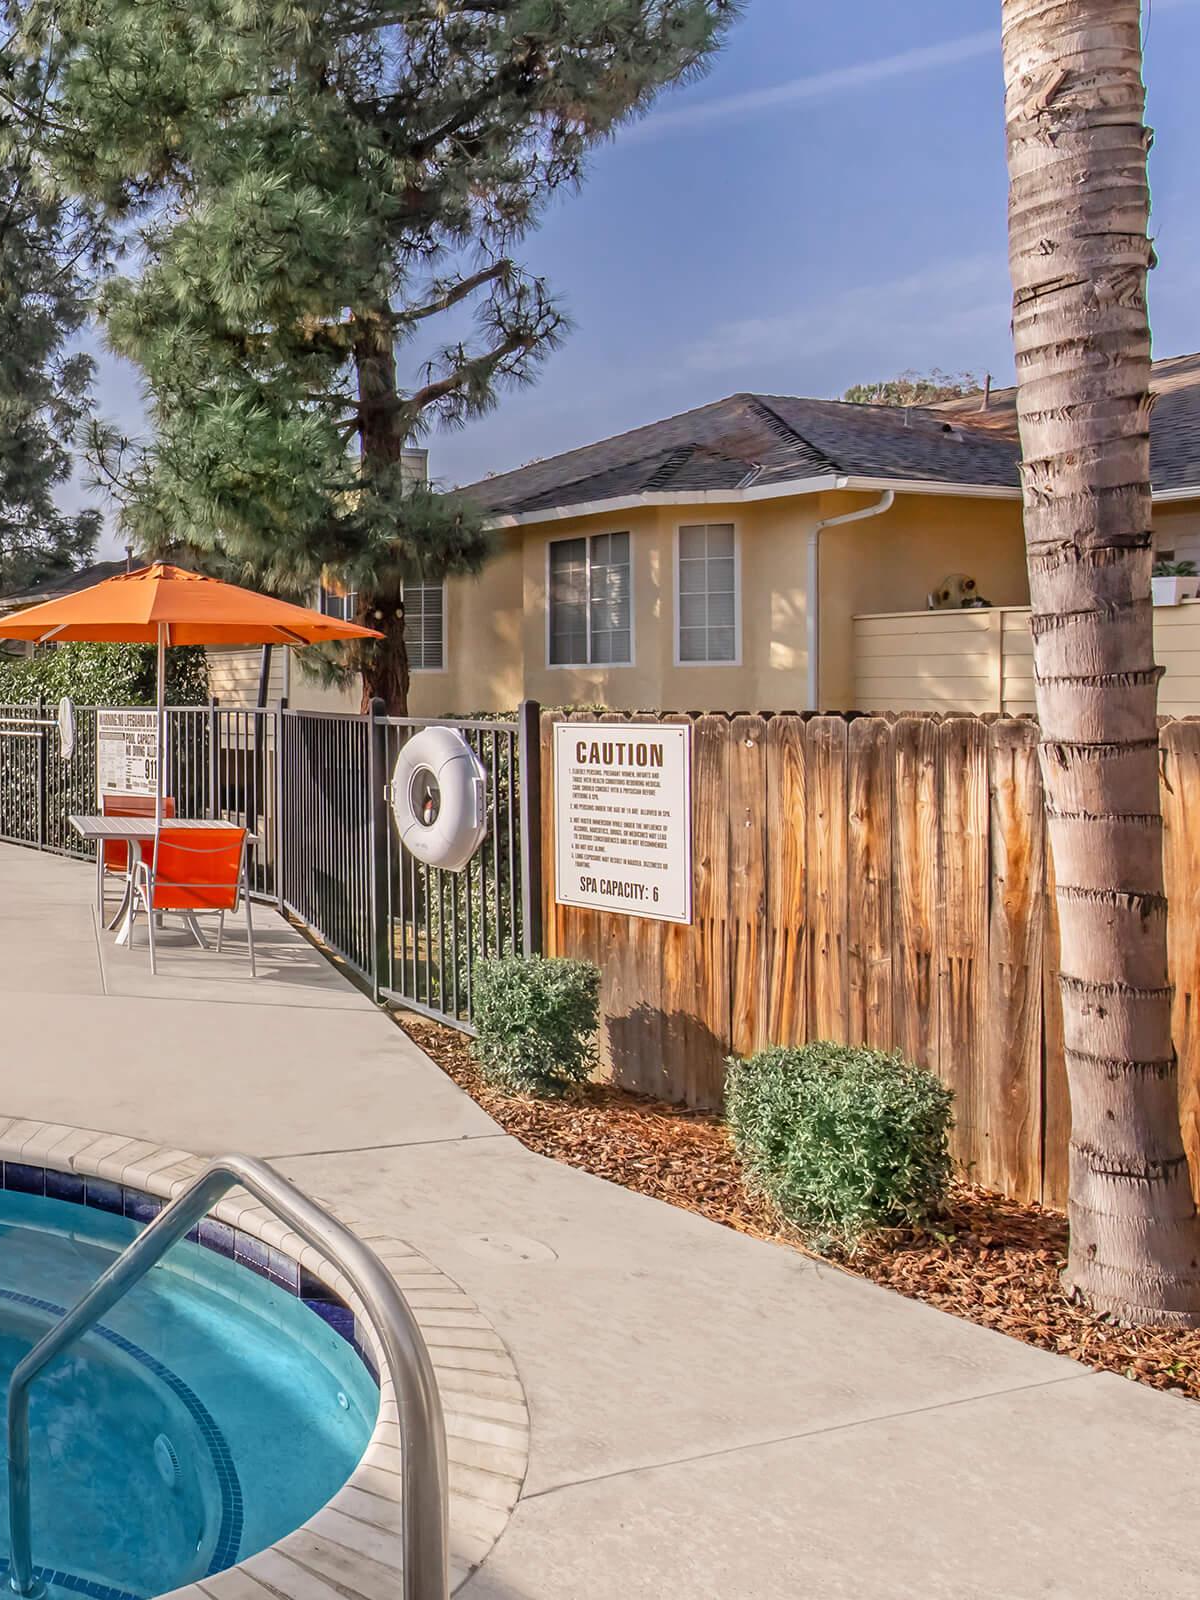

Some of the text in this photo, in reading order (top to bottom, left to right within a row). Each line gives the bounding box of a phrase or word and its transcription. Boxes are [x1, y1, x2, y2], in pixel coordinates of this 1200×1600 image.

[576, 741, 663, 767] CAUTION
[145, 759, 157, 780] 911
[580, 876, 659, 902] SPA CAPACITY: 6
